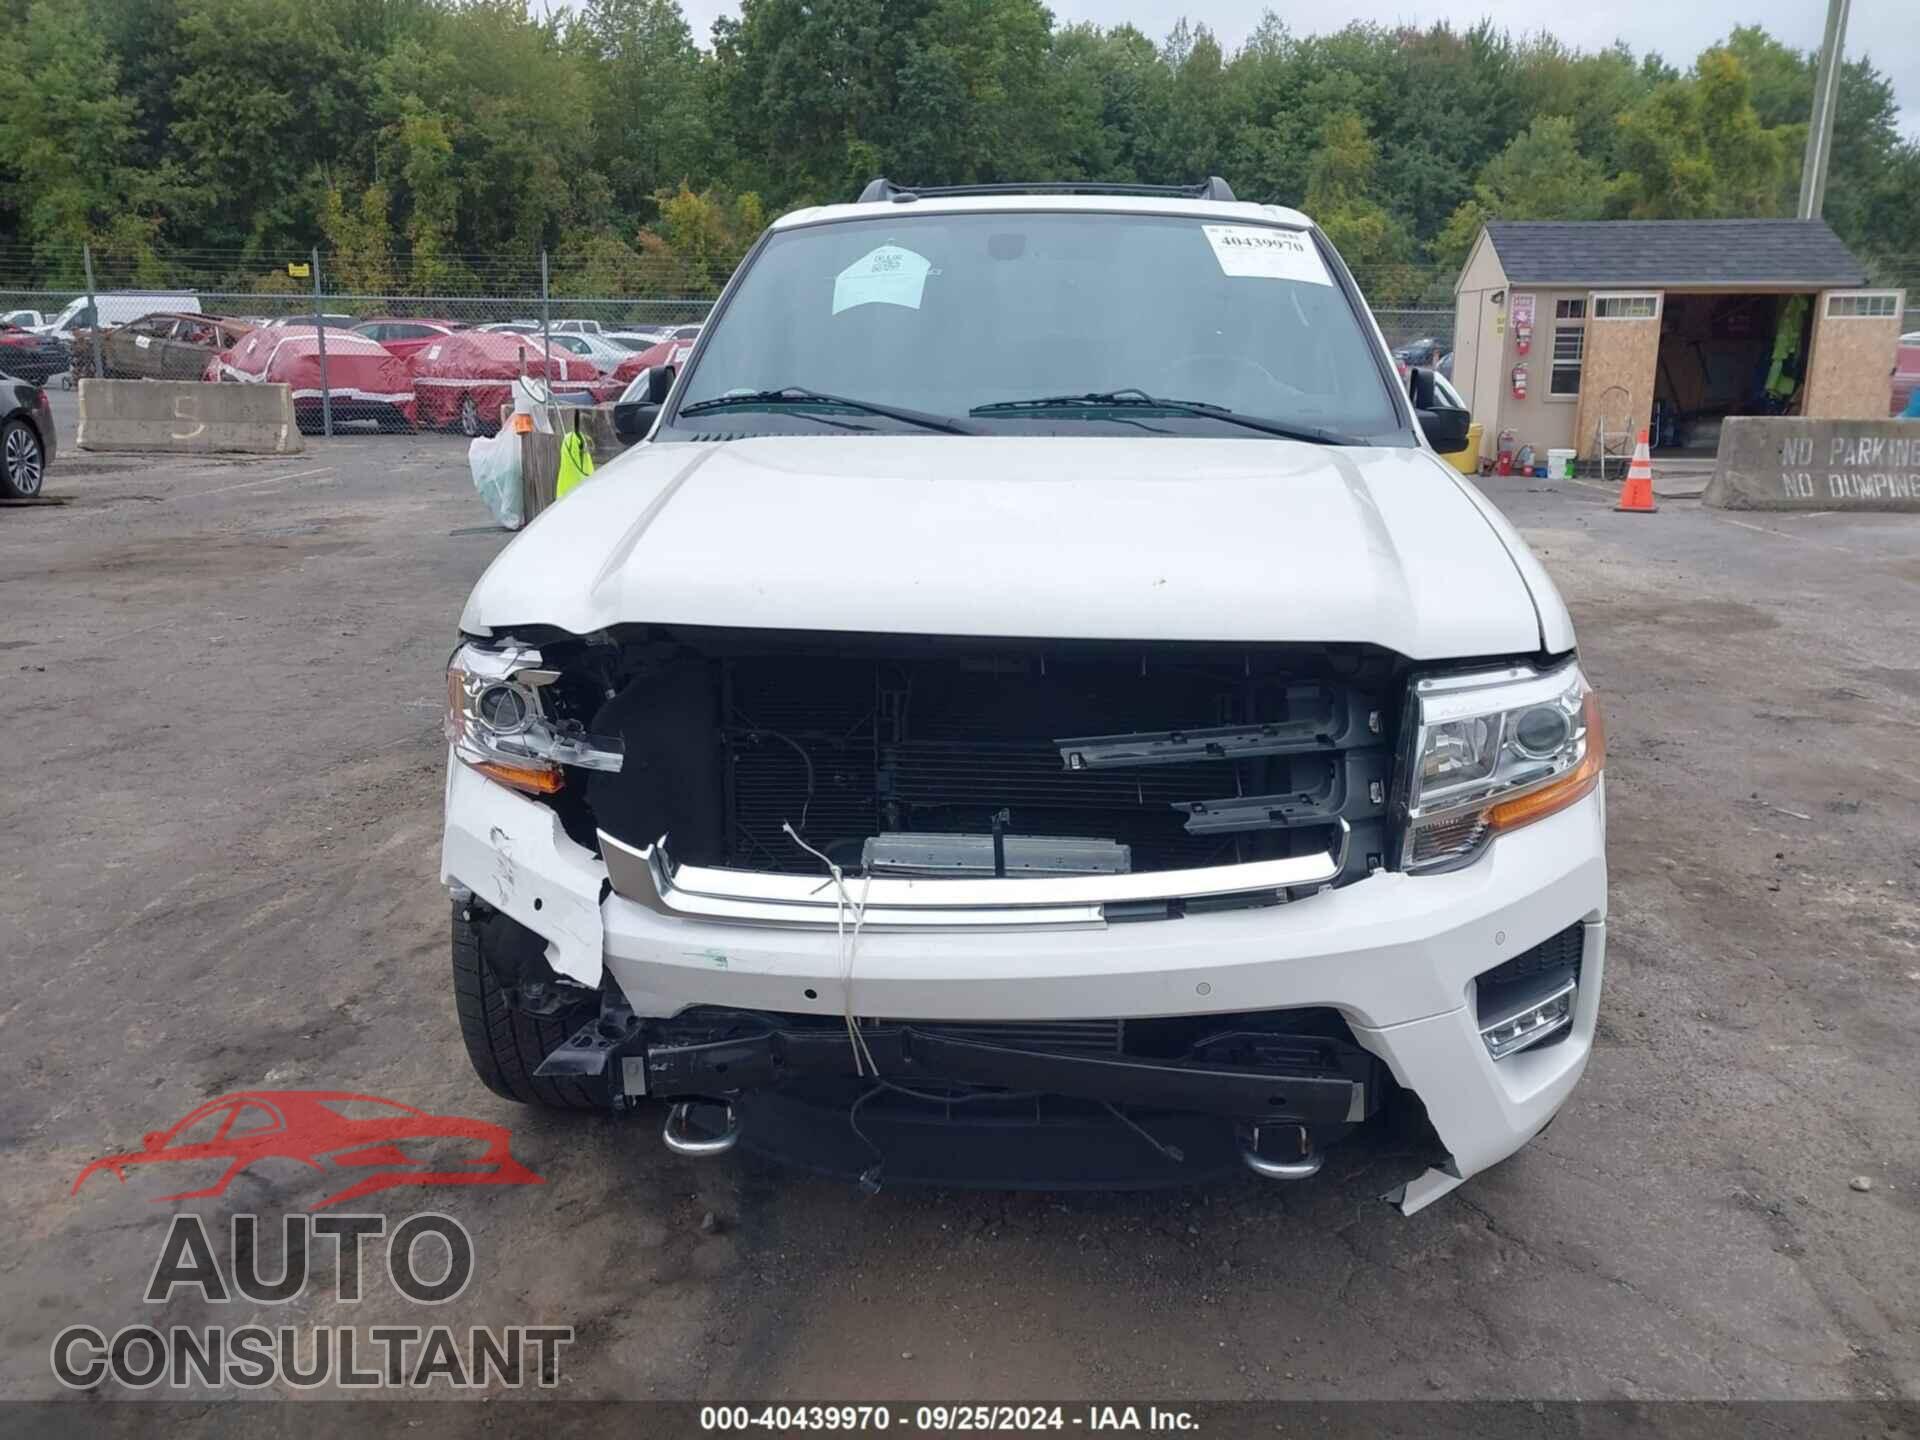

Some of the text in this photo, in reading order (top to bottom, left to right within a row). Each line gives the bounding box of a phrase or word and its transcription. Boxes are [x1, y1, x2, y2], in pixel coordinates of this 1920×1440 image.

[1221, 236, 1304, 252] 40439970
[1782, 437, 1814, 466] NO
[1782, 473, 1814, 497] NO
